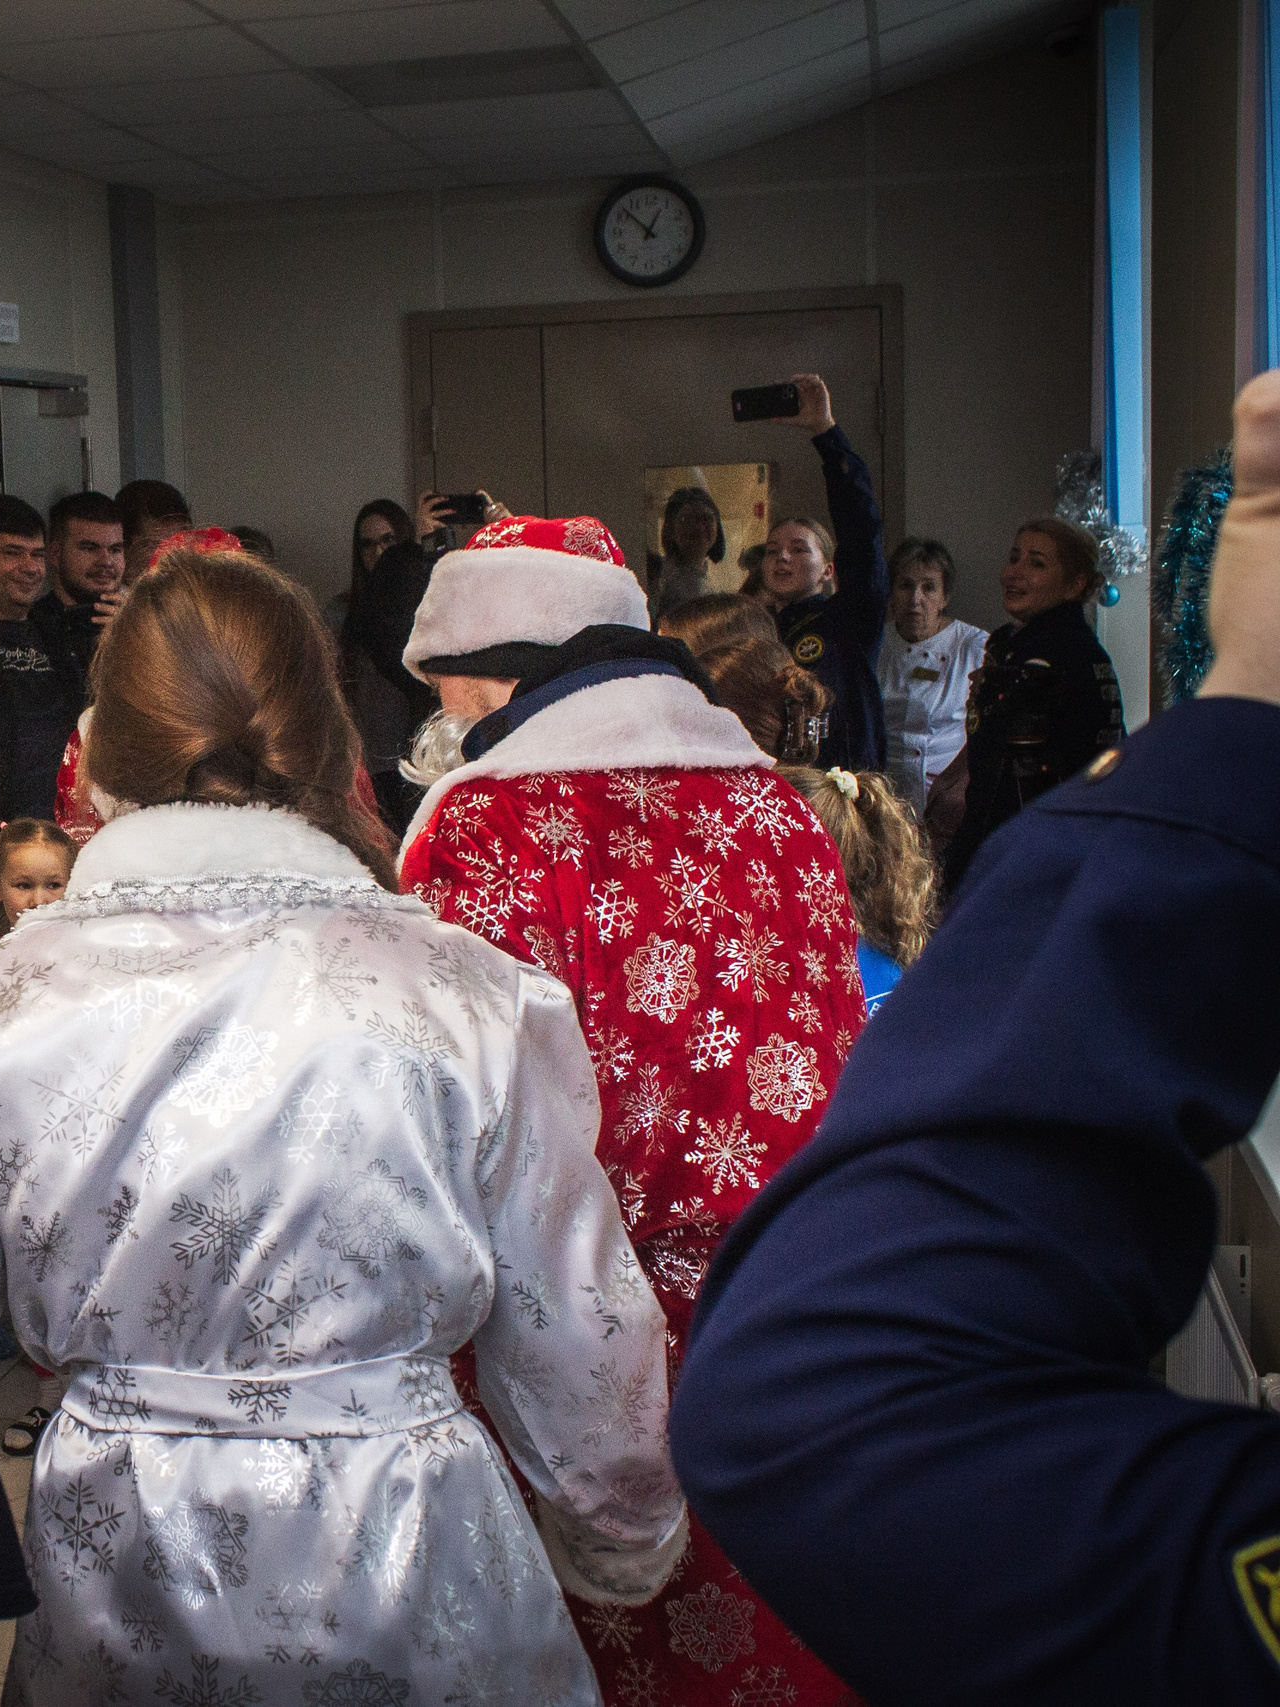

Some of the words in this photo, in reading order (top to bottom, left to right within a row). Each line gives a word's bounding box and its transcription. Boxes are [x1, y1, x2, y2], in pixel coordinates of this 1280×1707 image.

[629, 198, 640, 210] 11
[645, 194, 658, 206] 12
[613, 226, 622, 238] 9
[629, 254, 638, 266] 7
